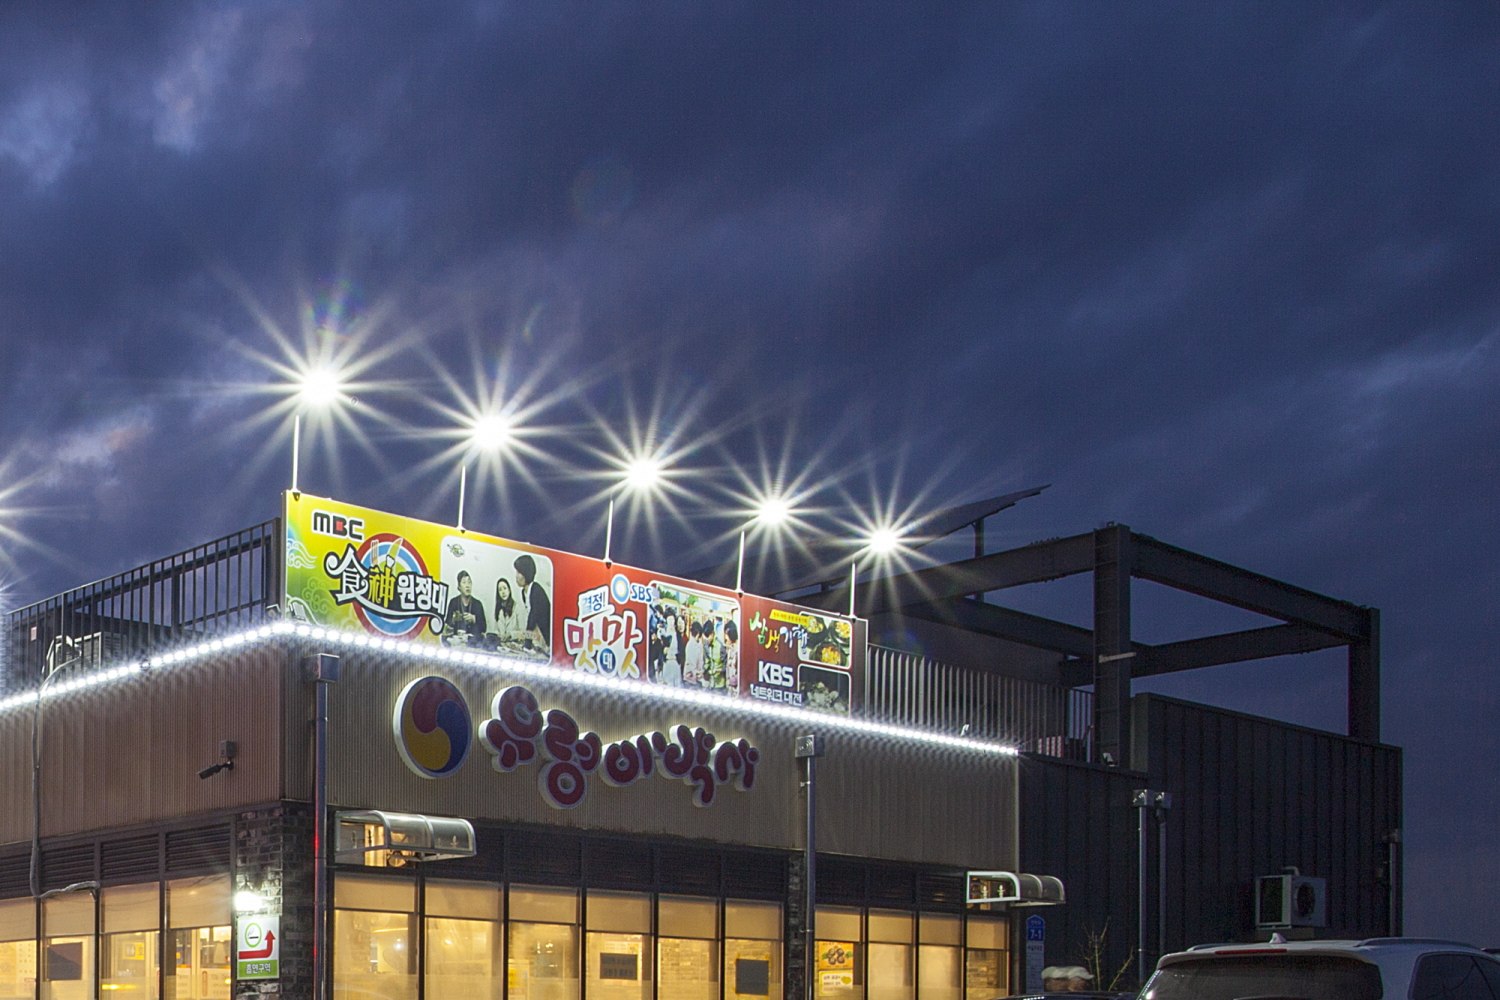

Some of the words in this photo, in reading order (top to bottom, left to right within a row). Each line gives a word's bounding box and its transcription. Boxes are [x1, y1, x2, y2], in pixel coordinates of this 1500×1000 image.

[313, 511, 363, 541] MBC
[631, 584, 652, 602] SBS
[758, 660, 794, 688] KBS
[750, 683, 782, 703] 네트워크
[783, 691, 802, 706] 대전
[479, 686, 759, 808] 우렁이박사
[1030, 929, 1042, 940] 7-1
[245, 962, 271, 975] 흡연구역
